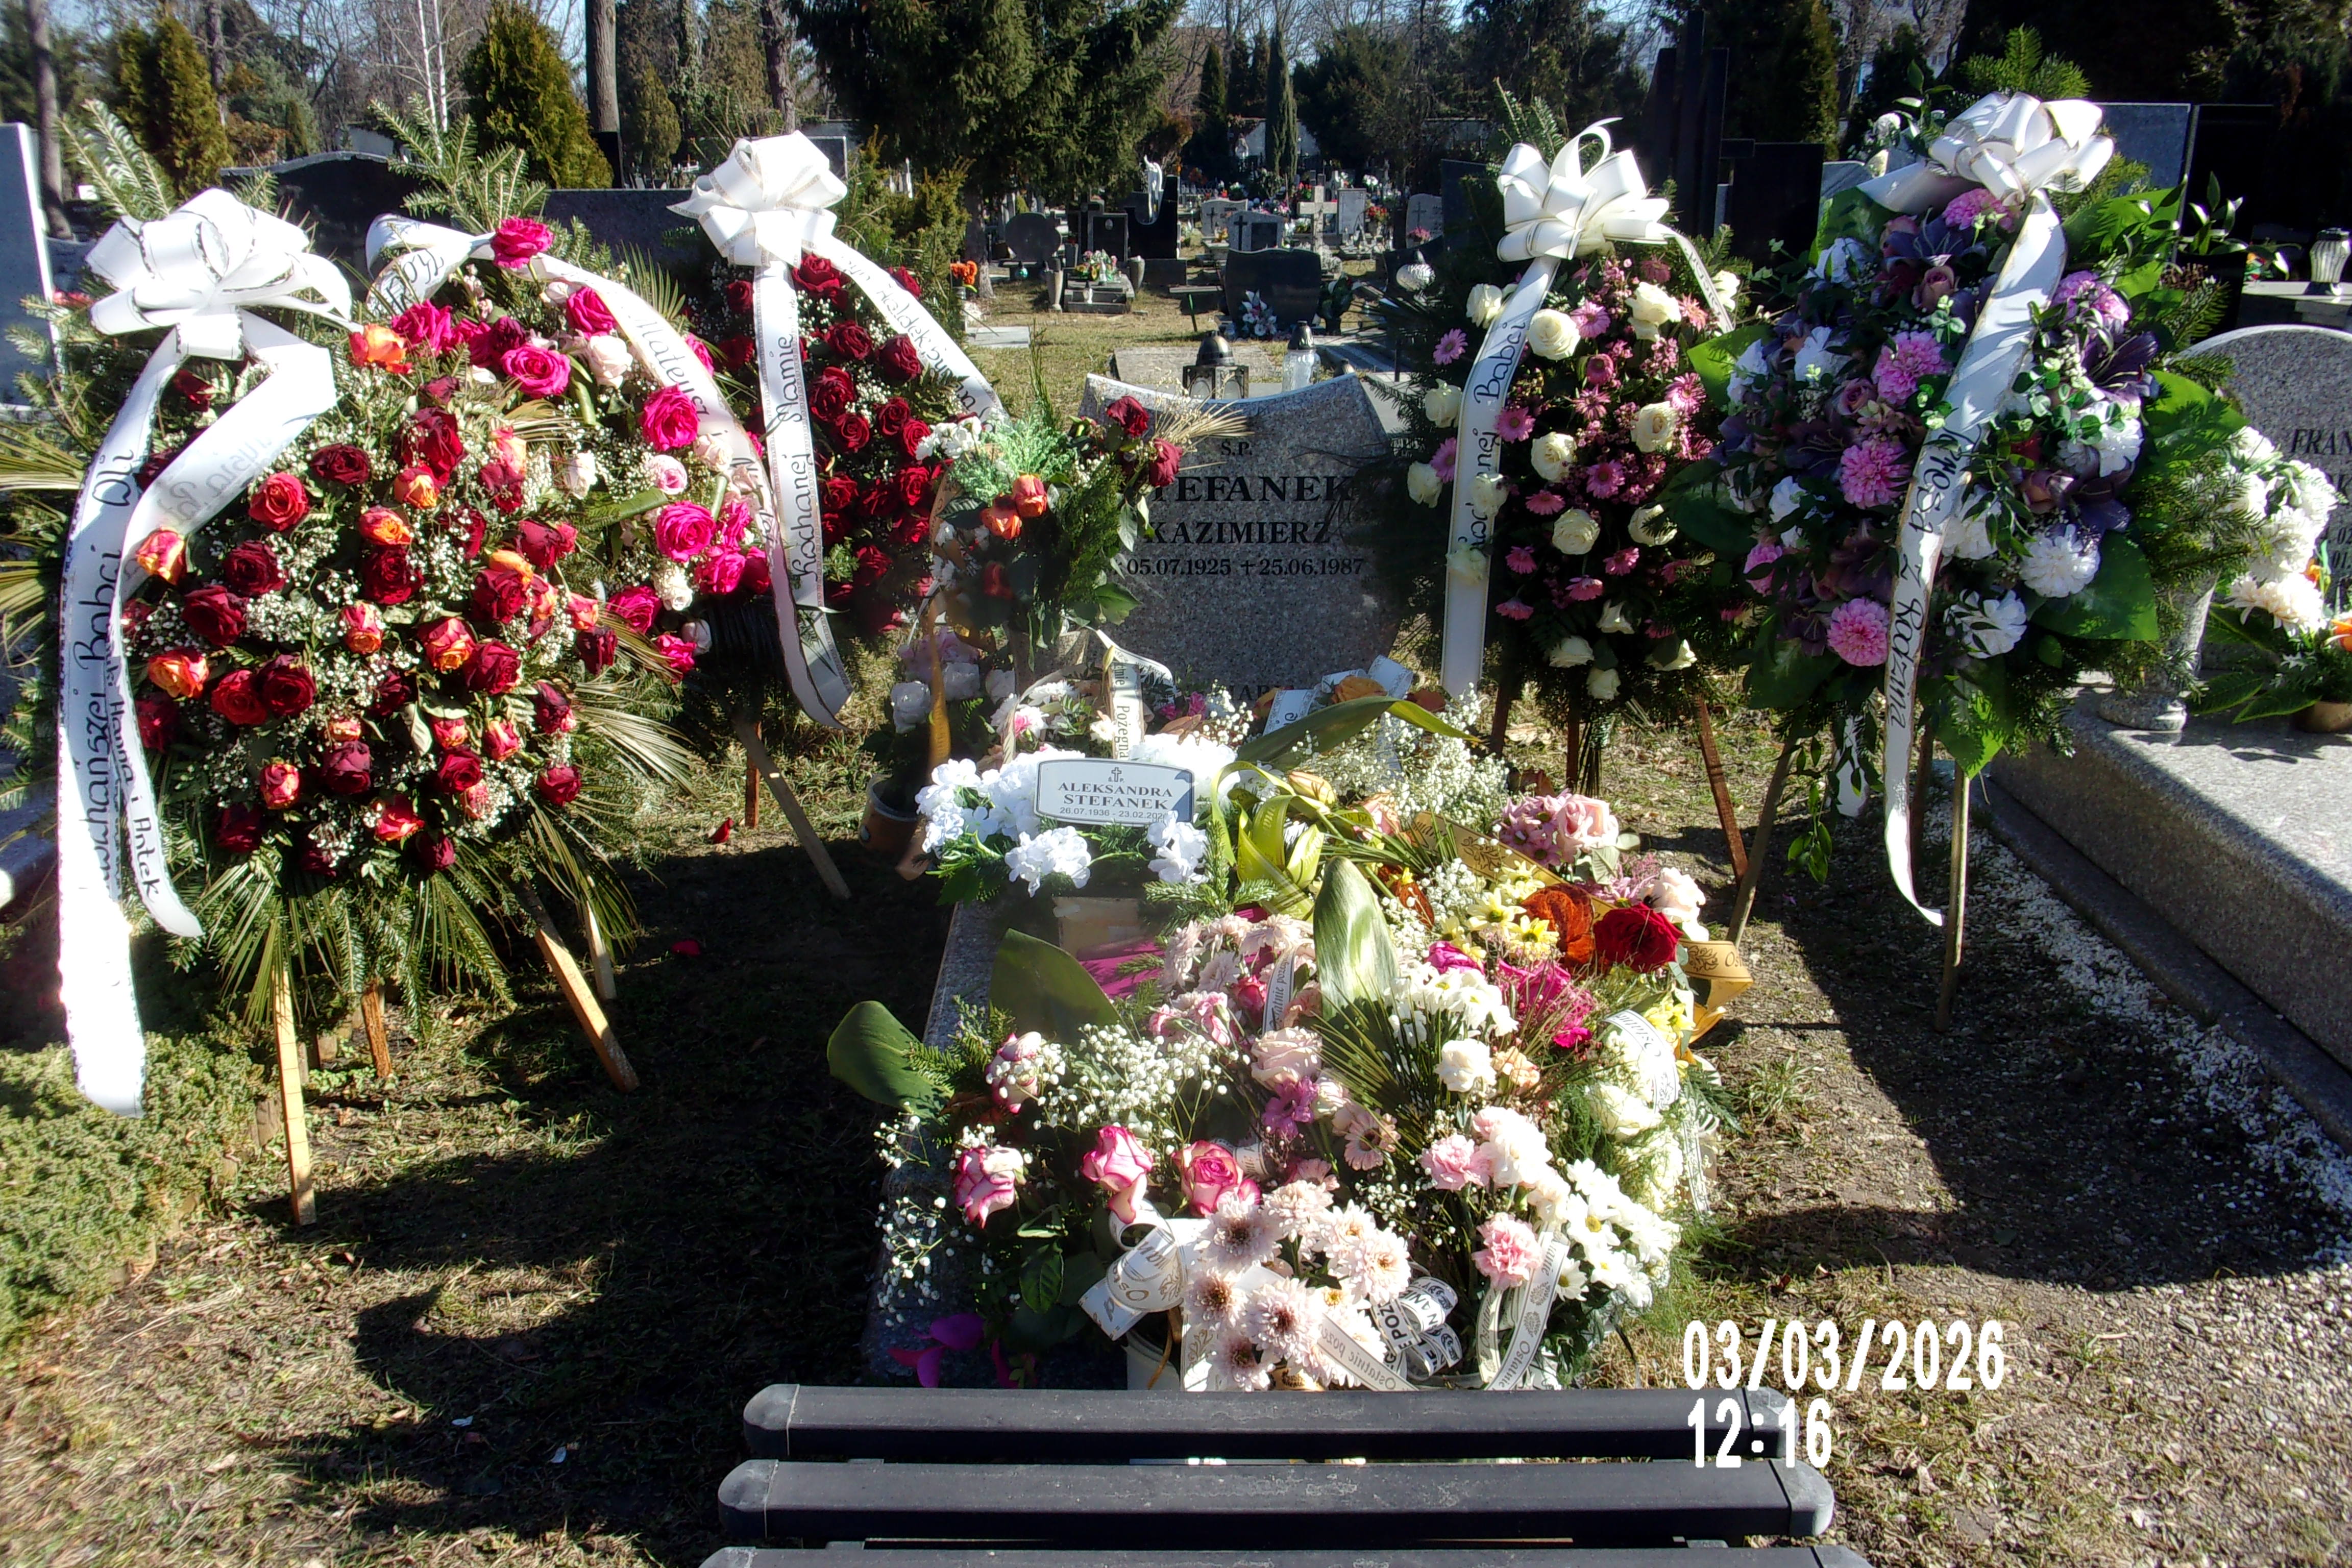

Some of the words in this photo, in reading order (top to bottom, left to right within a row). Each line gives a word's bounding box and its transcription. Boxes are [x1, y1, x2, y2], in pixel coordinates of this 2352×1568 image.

[769, 334, 803, 423] Mamie
[1473, 322, 1527, 404] Babci
[783, 453, 818, 582] Kochanej
[1144, 521, 1330, 545] KAZIMIERZ
[73, 544, 122, 670] Babci
[108, 699, 133, 782] Hanna
[134, 817, 159, 896] Antek
[1058, 781, 1172, 797] ALEKSANDRA
[1060, 807, 1110, 817] 26.07.1936
[1064, 794, 1168, 810] STEFANEK
[1498, 1340, 1531, 1389] Ostatnie
